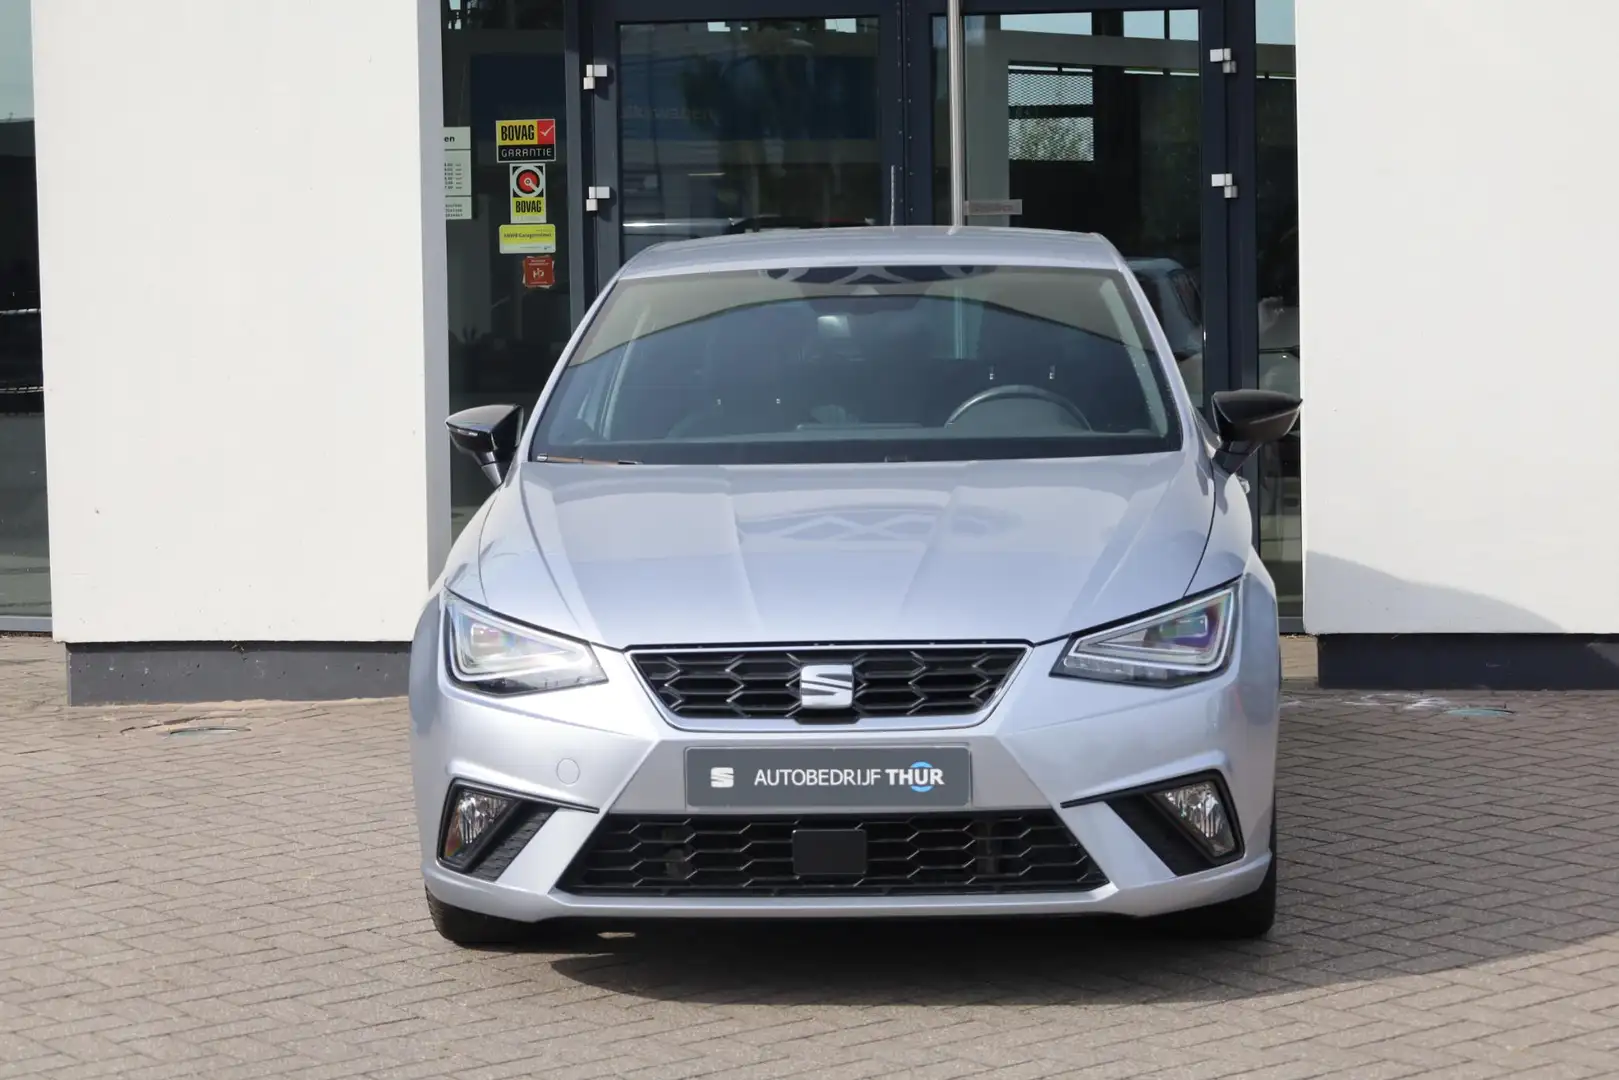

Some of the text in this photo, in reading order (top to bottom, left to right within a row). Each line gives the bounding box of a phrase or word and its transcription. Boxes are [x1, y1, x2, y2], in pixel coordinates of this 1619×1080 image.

[501, 124, 535, 141] BOVAG
[501, 148, 552, 158] GARANTIE
[515, 200, 542, 213] BOVAG
[754, 768, 882, 786] AUTOBEDRIJF
[885, 768, 945, 786] THUR
